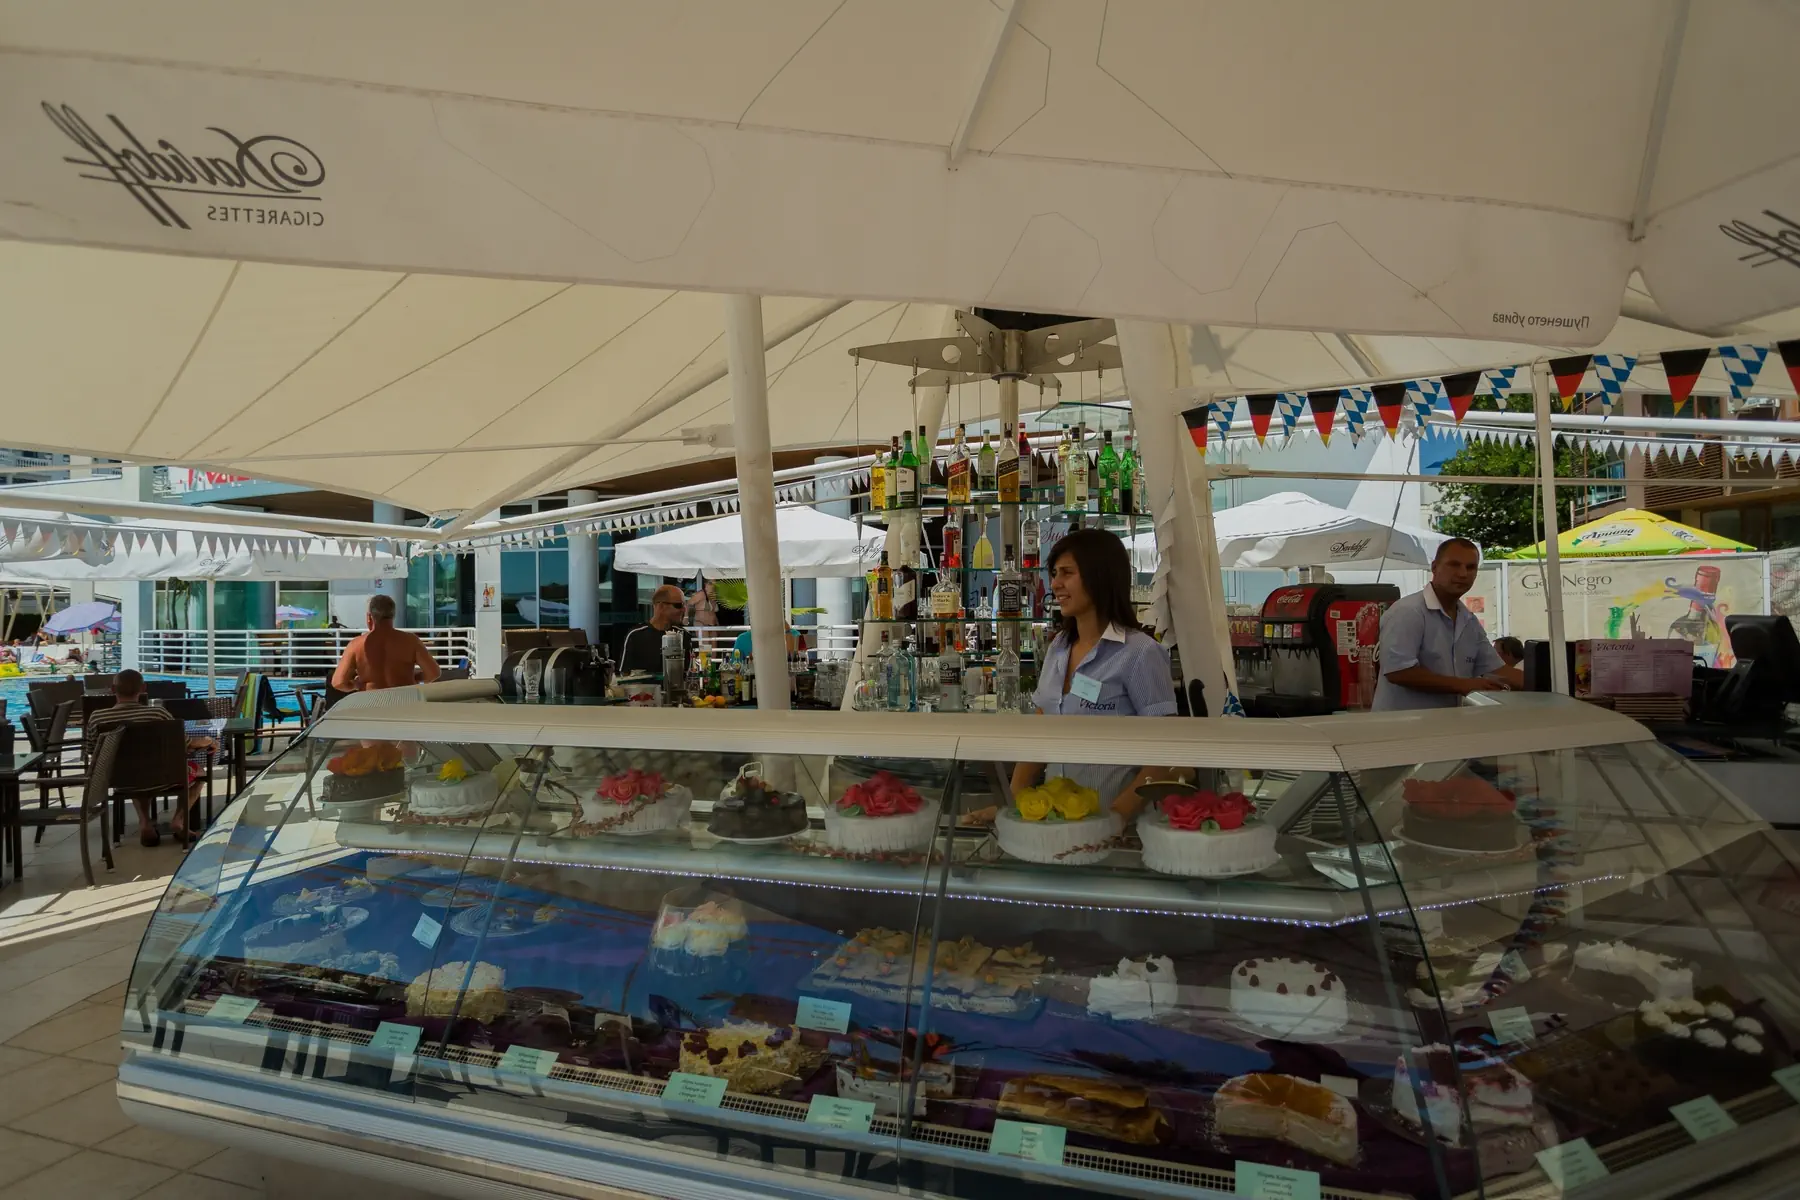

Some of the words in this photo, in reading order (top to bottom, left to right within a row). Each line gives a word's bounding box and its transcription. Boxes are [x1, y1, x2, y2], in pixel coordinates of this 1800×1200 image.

[1562, 573, 1612, 590] Negro
[1596, 642, 1635, 651] Victoria
[1080, 699, 1116, 711] Victoria
